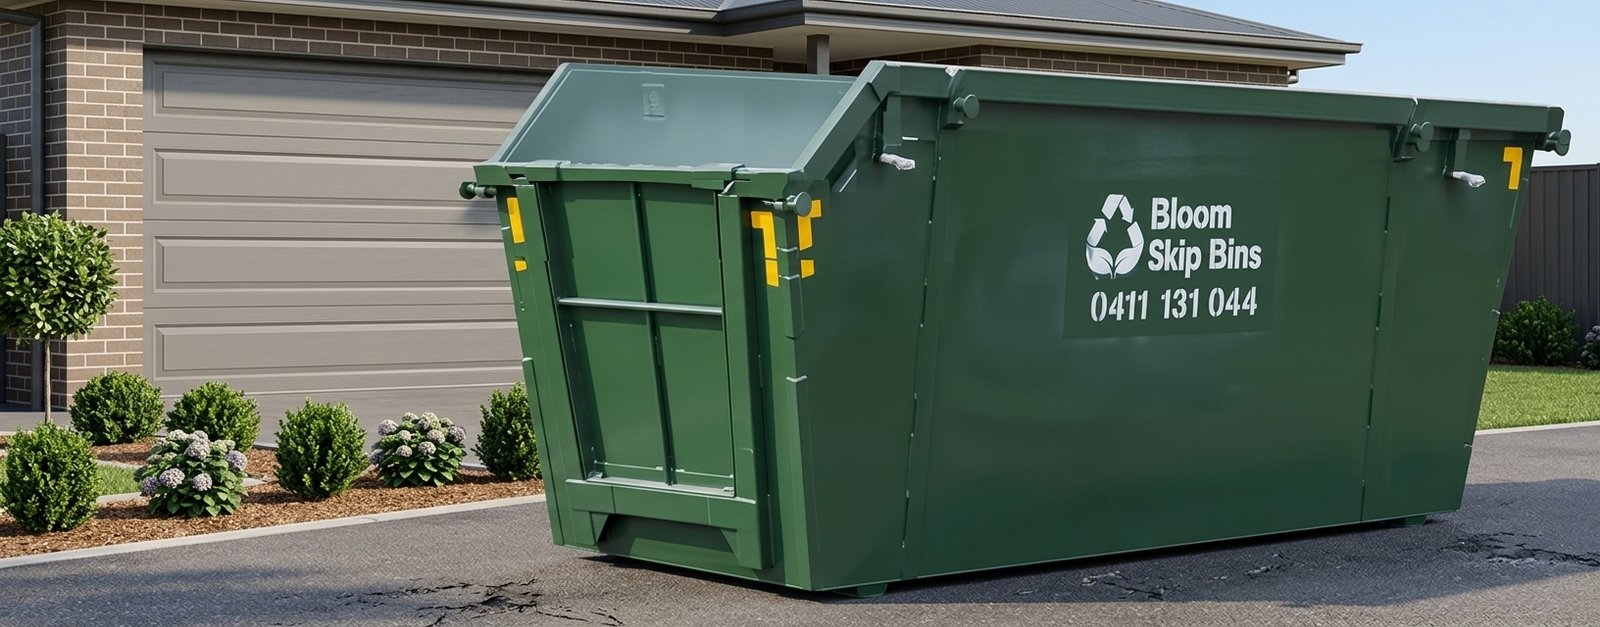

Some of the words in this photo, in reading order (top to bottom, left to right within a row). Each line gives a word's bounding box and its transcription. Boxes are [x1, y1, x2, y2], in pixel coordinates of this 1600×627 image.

[1151, 197, 1232, 230] Bloom
[1147, 239, 1202, 279] Skip
[1208, 238, 1262, 270] Bins
[1090, 290, 1149, 322] 0411
[1160, 288, 1200, 319] 131
[1208, 286, 1258, 318] 044
